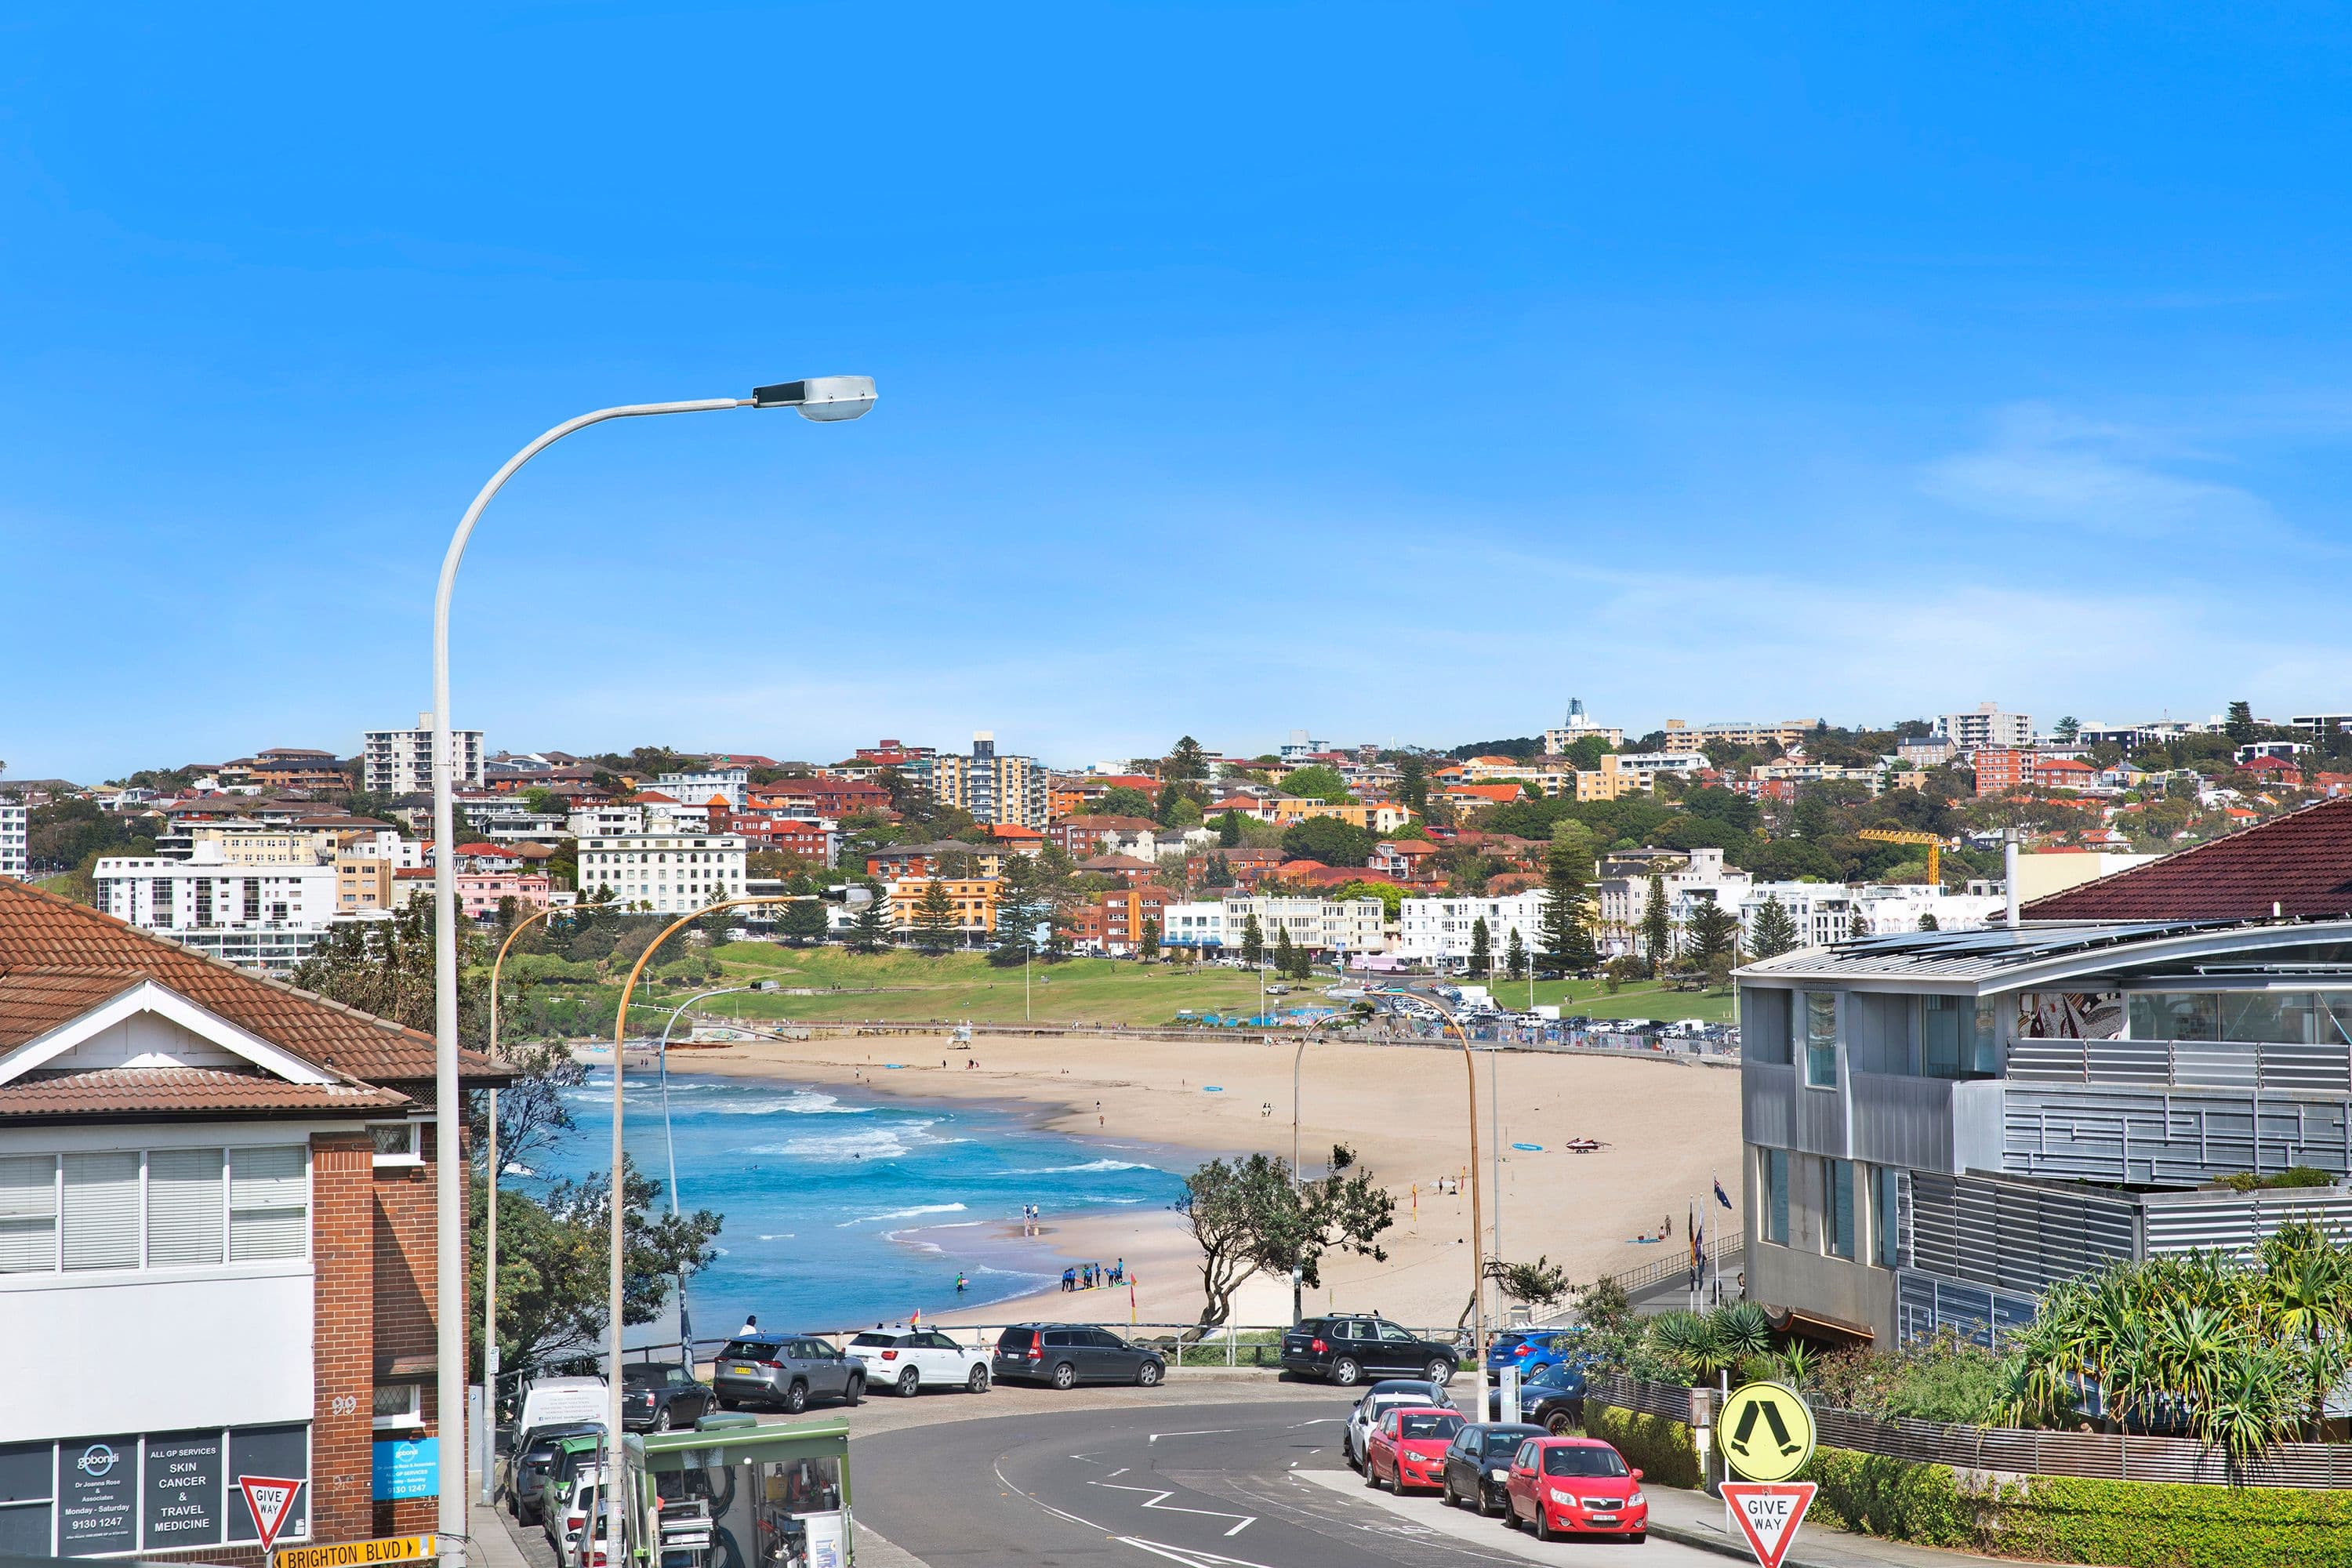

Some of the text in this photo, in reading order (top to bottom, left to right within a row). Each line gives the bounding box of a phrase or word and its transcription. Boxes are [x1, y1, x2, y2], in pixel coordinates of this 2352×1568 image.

[332, 1396, 357, 1415] 99
[179, 1447, 216, 1457] SERVICES
[77, 1453, 119, 1469] gobondi
[169, 1462, 197, 1473] SKIN
[158, 1475, 206, 1489] CANCER
[179, 1492, 187, 1501] &
[256, 1490, 282, 1503] GIVE
[65, 1507, 93, 1515] Monday
[98, 1504, 130, 1512] Saturday
[161, 1504, 205, 1517] TRAVEL
[260, 1504, 278, 1515] WAY
[1748, 1501, 1788, 1515] GIVE
[72, 1517, 123, 1529] 9130 1247
[154, 1518, 209, 1532] MEDICINE
[1755, 1518, 1783, 1530] WAY
[289, 1541, 401, 1568] BRIGHTON BLVD
